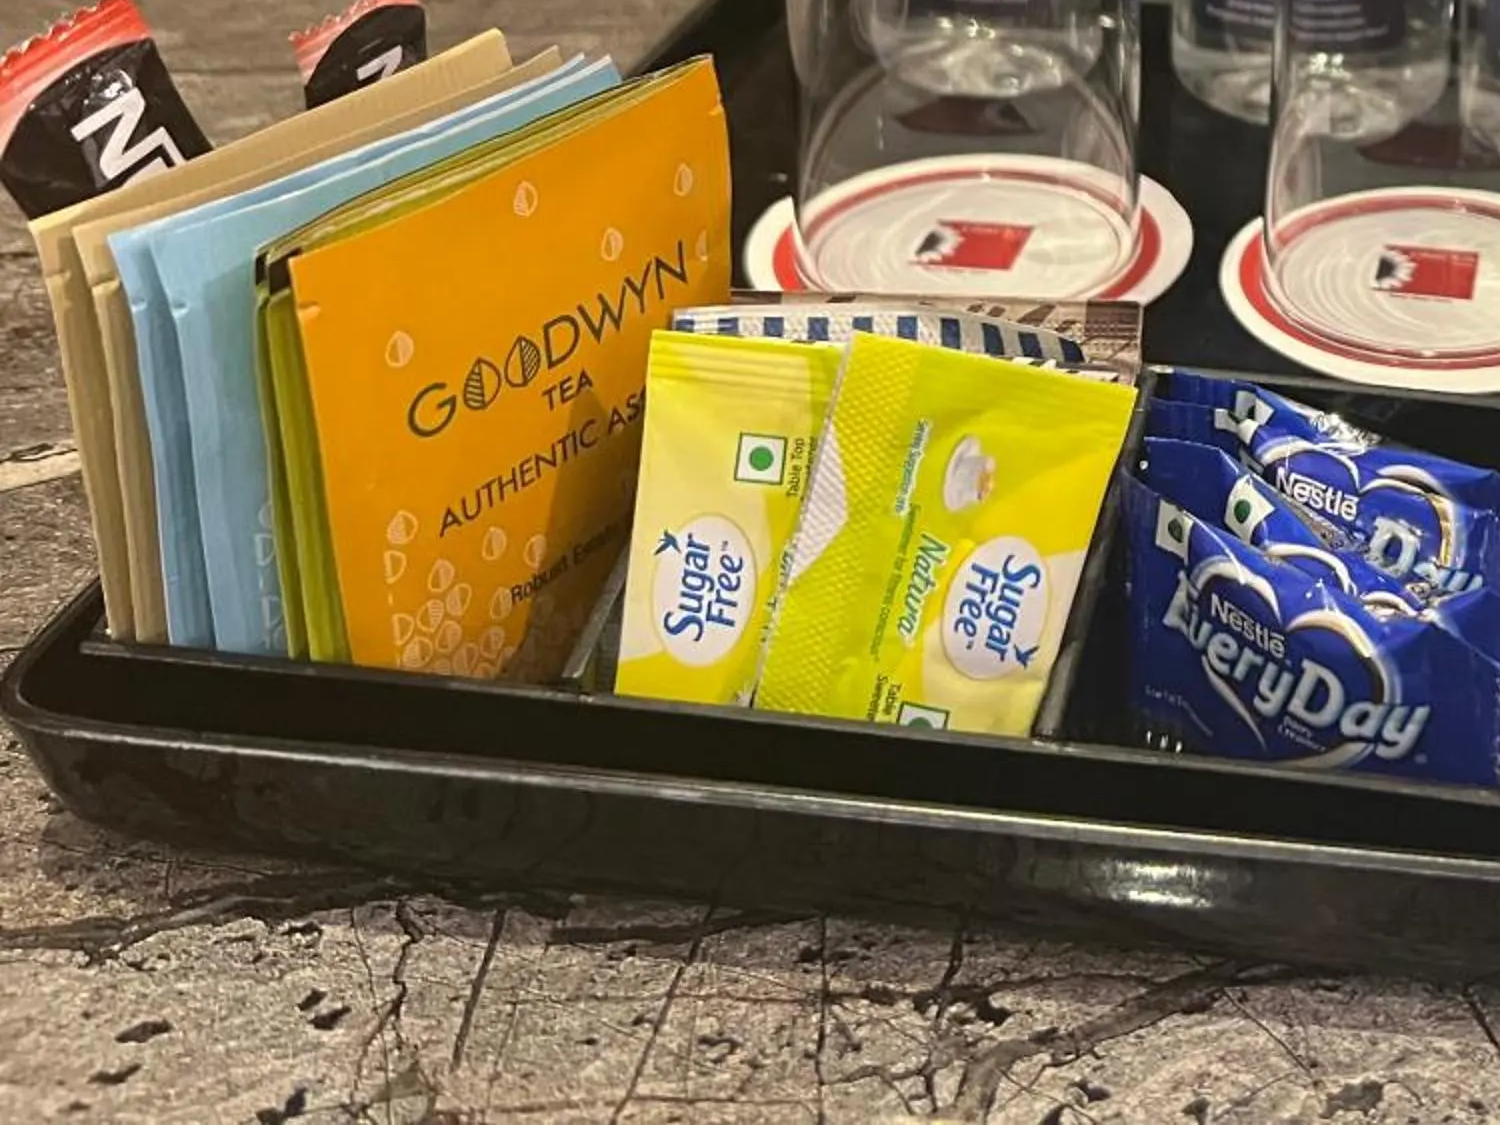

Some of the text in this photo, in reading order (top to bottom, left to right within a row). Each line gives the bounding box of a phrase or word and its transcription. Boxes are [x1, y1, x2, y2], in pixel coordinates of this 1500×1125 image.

[407, 240, 688, 437] GOODWYN
[542, 368, 593, 412] TEA
[438, 383, 646, 538] AUTHENTIC AS
[663, 532, 715, 642] Sugar
[705, 554, 744, 627] Free
[896, 531, 950, 638] Natura
[954, 562, 999, 638] Free
[985, 554, 1041, 662] Sugar
[1210, 592, 1287, 660] Nestlé
[1162, 569, 1431, 761] EveryDay
